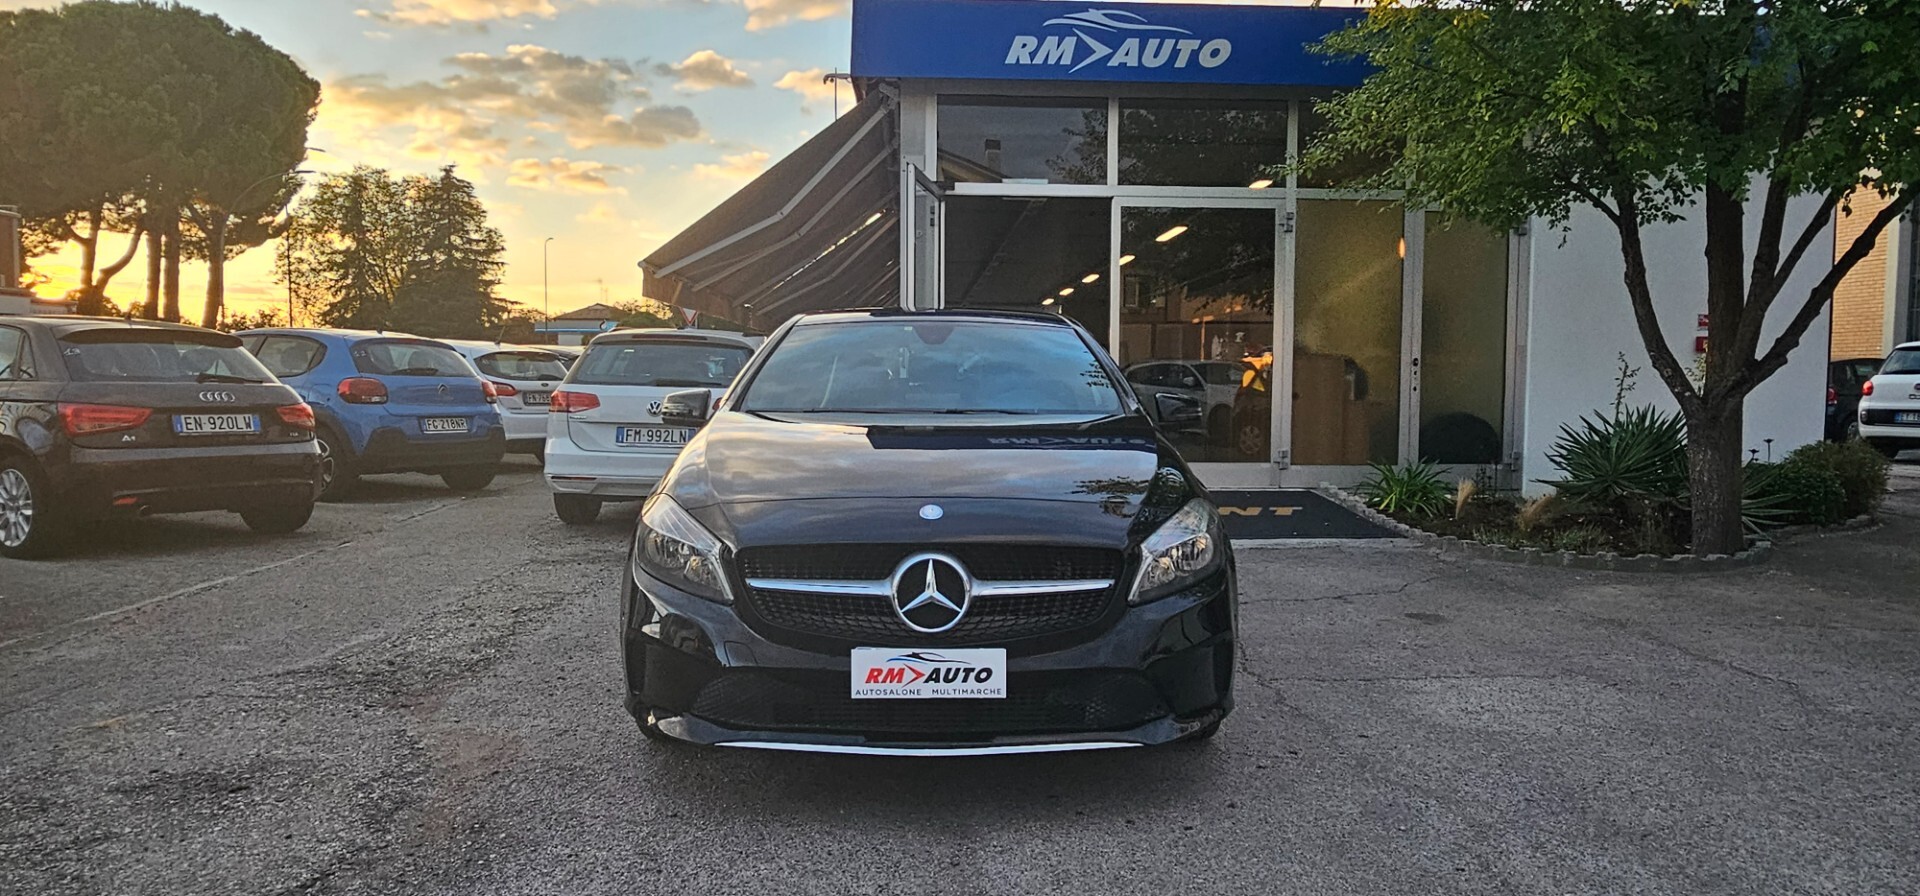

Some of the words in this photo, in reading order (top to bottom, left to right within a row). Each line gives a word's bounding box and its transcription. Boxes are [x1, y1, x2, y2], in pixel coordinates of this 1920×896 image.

[1004, 35, 1077, 65] RM
[1107, 38, 1232, 68] AUTO
[864, 667, 906, 684] RM
[922, 667, 993, 684] AUTO
[855, 688, 922, 696] AUTOSALONE
[931, 688, 1002, 696] MULTIMARCHE
